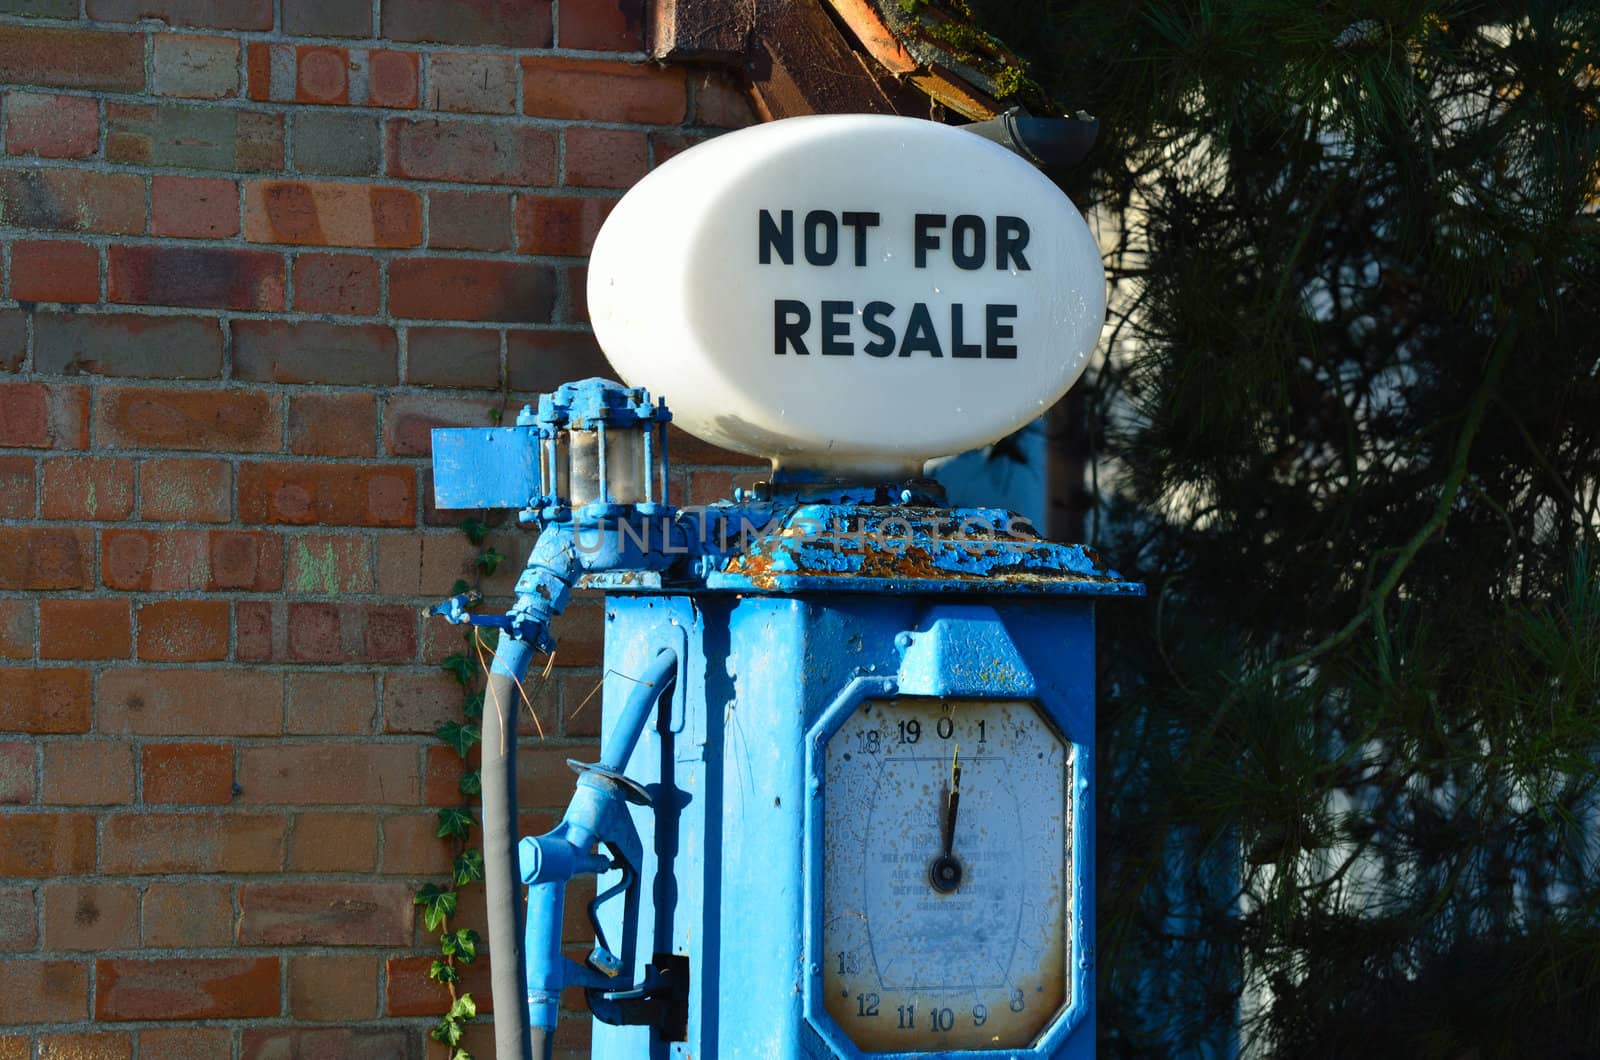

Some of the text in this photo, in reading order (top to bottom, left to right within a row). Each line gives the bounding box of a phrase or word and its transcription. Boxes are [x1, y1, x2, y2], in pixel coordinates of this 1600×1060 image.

[758, 209, 1032, 271] NOT FOR
[774, 299, 1018, 359] RESALE
[898, 719, 921, 744] 19
[936, 716, 954, 740] 0
[978, 719, 987, 744] 1
[856, 730, 881, 754] 18
[838, 952, 859, 975] 13
[856, 992, 880, 1017] 12
[1009, 988, 1024, 1013] 8
[897, 1005, 915, 1029] 11
[930, 1007, 954, 1032] 10
[972, 1003, 987, 1026] 9
